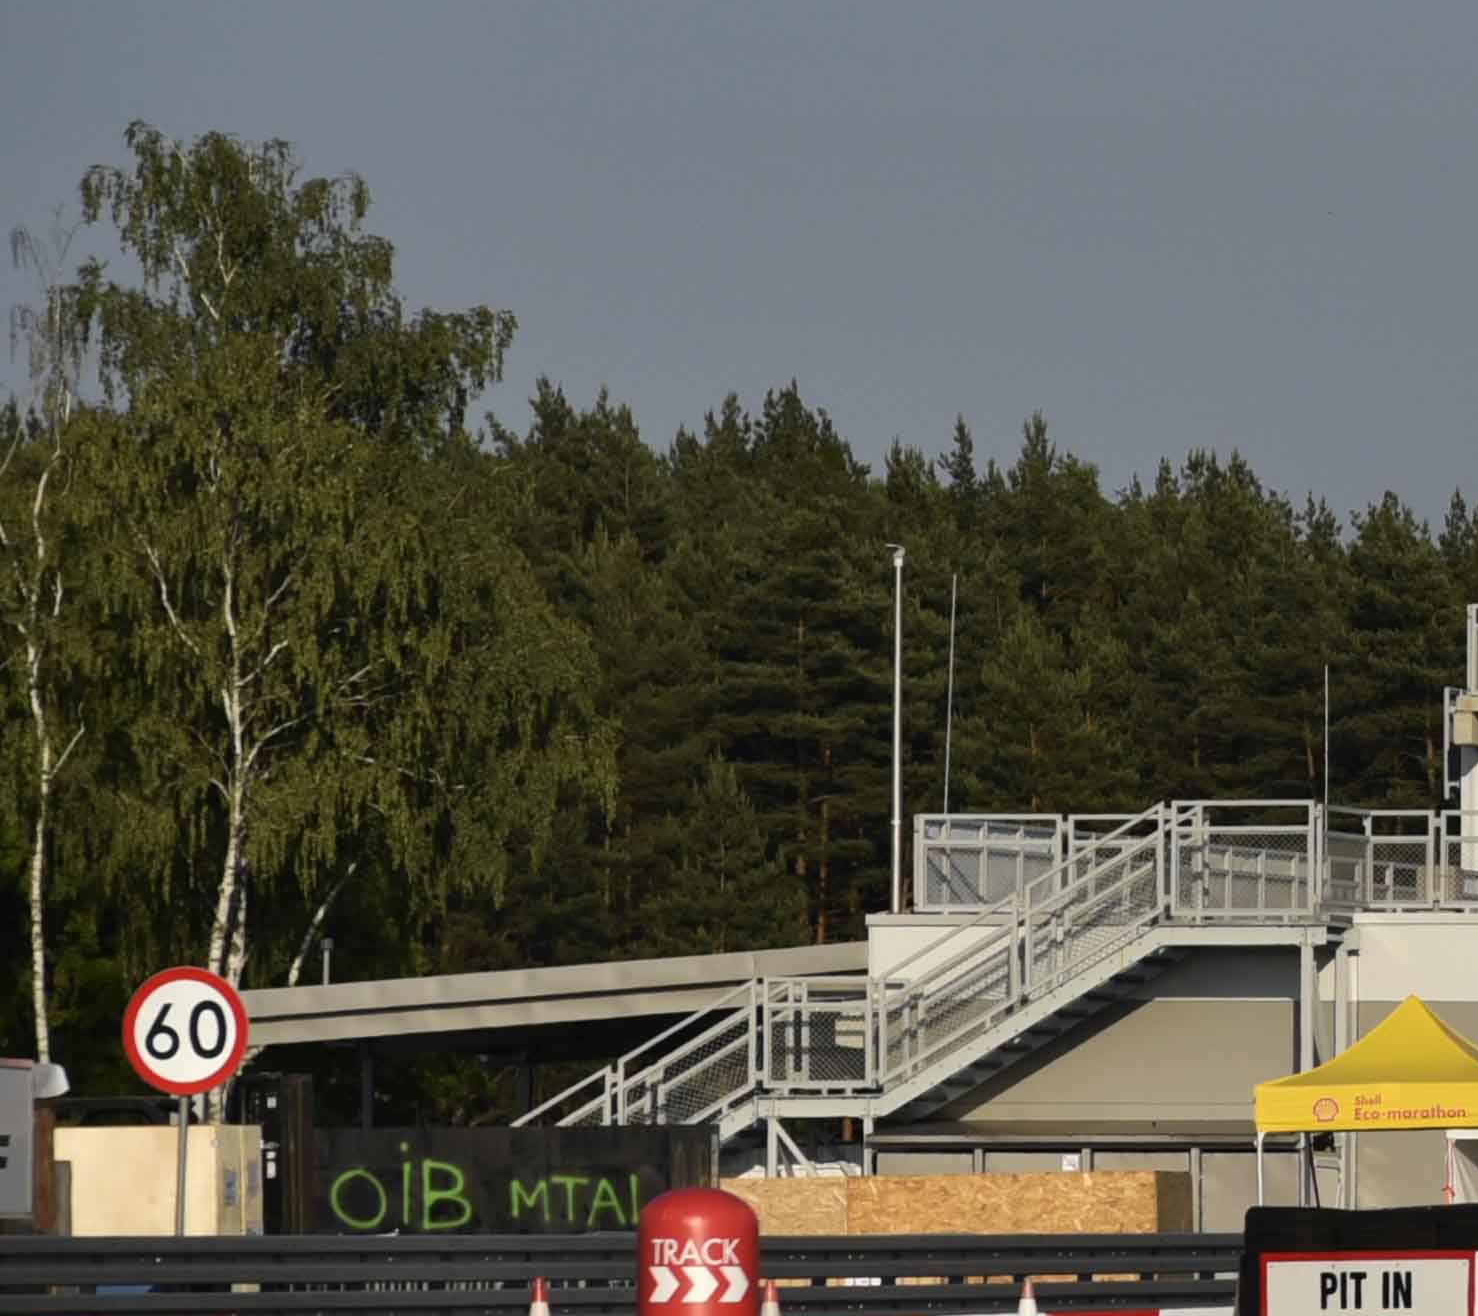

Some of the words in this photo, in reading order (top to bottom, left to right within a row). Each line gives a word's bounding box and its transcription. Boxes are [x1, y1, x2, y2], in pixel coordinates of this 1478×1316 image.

[145, 1000, 227, 1060] 60
[651, 1238, 741, 1265] TRACK
[1320, 1271, 1367, 1309] PIT
[1382, 1271, 1413, 1309] IN
